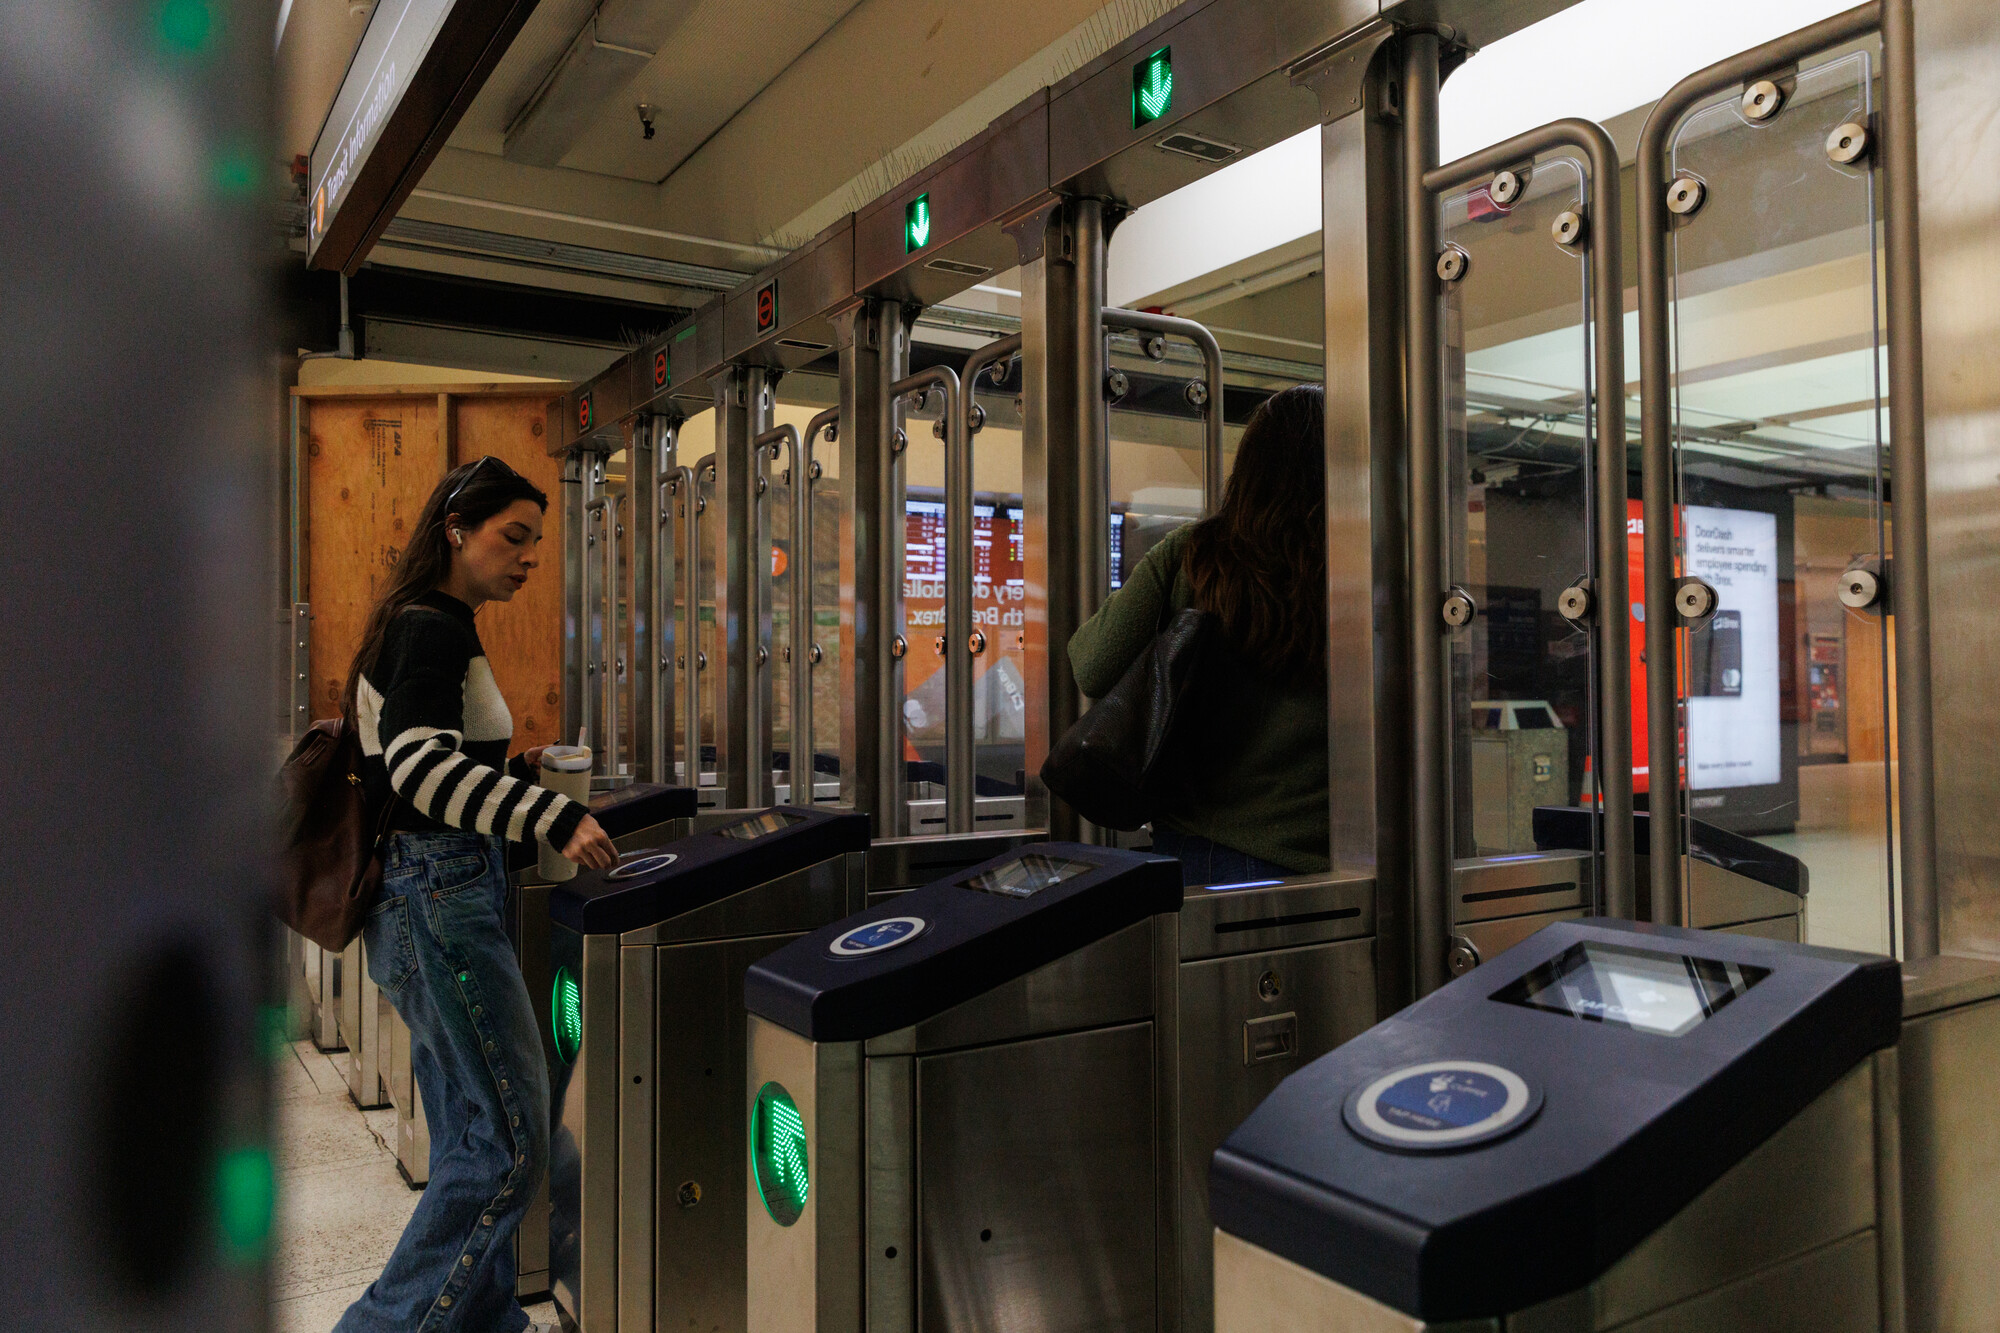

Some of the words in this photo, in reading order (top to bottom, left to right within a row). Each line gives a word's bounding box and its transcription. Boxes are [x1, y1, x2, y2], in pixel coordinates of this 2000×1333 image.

[327, 148, 348, 209] Transit
[350, 61, 395, 168] Information
[1695, 525, 1732, 540] DoorDash
[1575, 998, 1608, 1010] TAP
[1608, 1004, 1651, 1019] CARD
